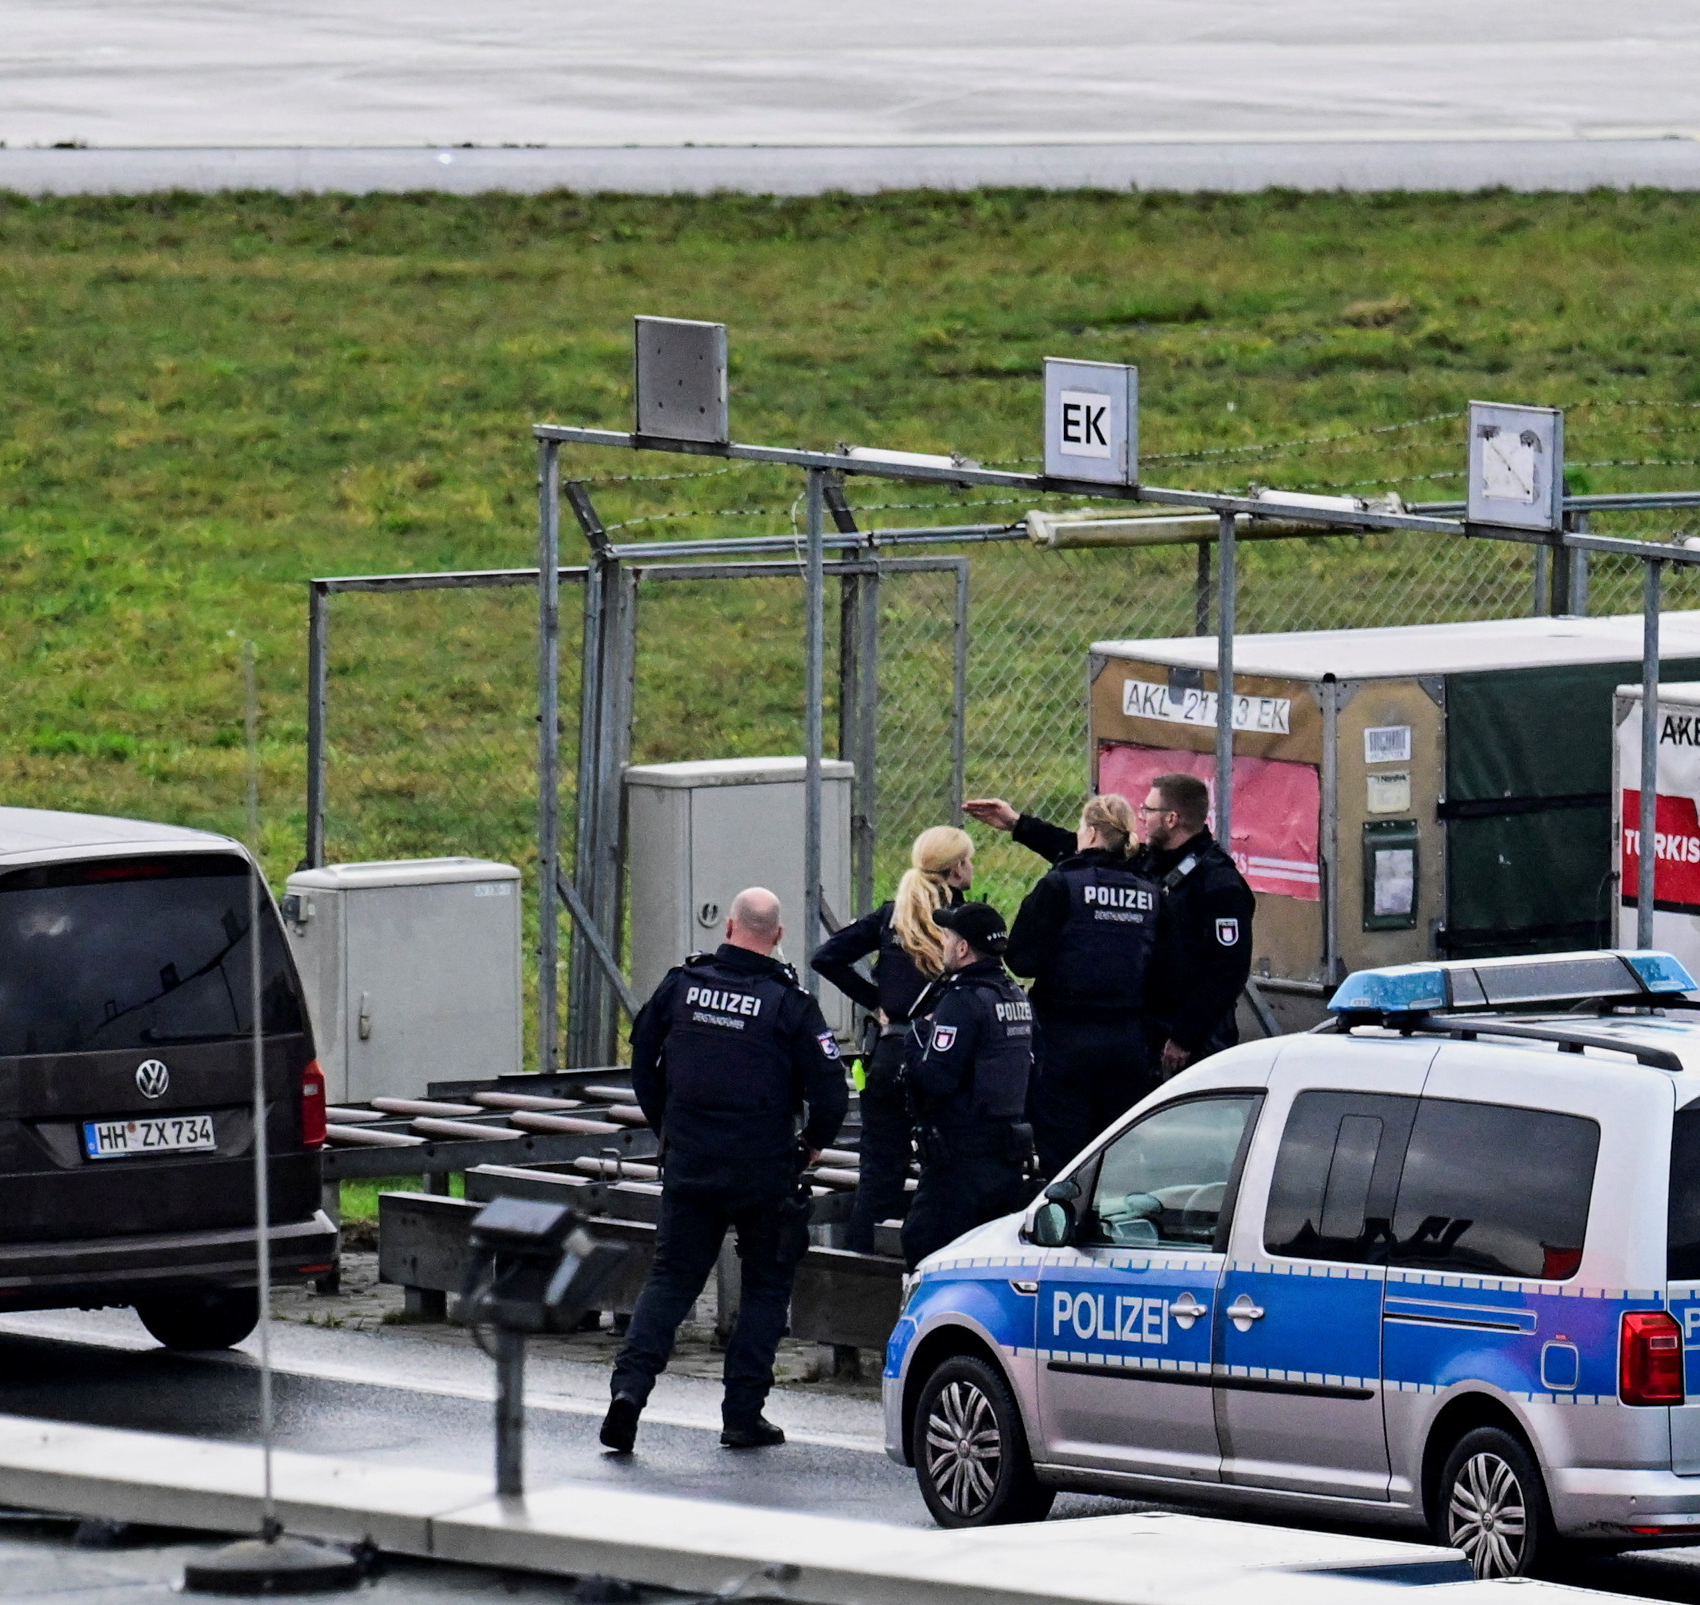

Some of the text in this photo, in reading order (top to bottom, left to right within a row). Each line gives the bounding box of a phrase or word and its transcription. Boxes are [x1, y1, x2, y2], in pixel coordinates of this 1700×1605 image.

[1063, 403, 1107, 446] EK
[1126, 683, 1169, 718] AKL
[1256, 699, 1286, 731] EK
[1084, 885, 1153, 911] POLIZEI
[685, 986, 762, 1017] POLIZEI
[98, 1118, 211, 1149] HH ZX 734
[1052, 1290, 1169, 1345] POLIZEI
